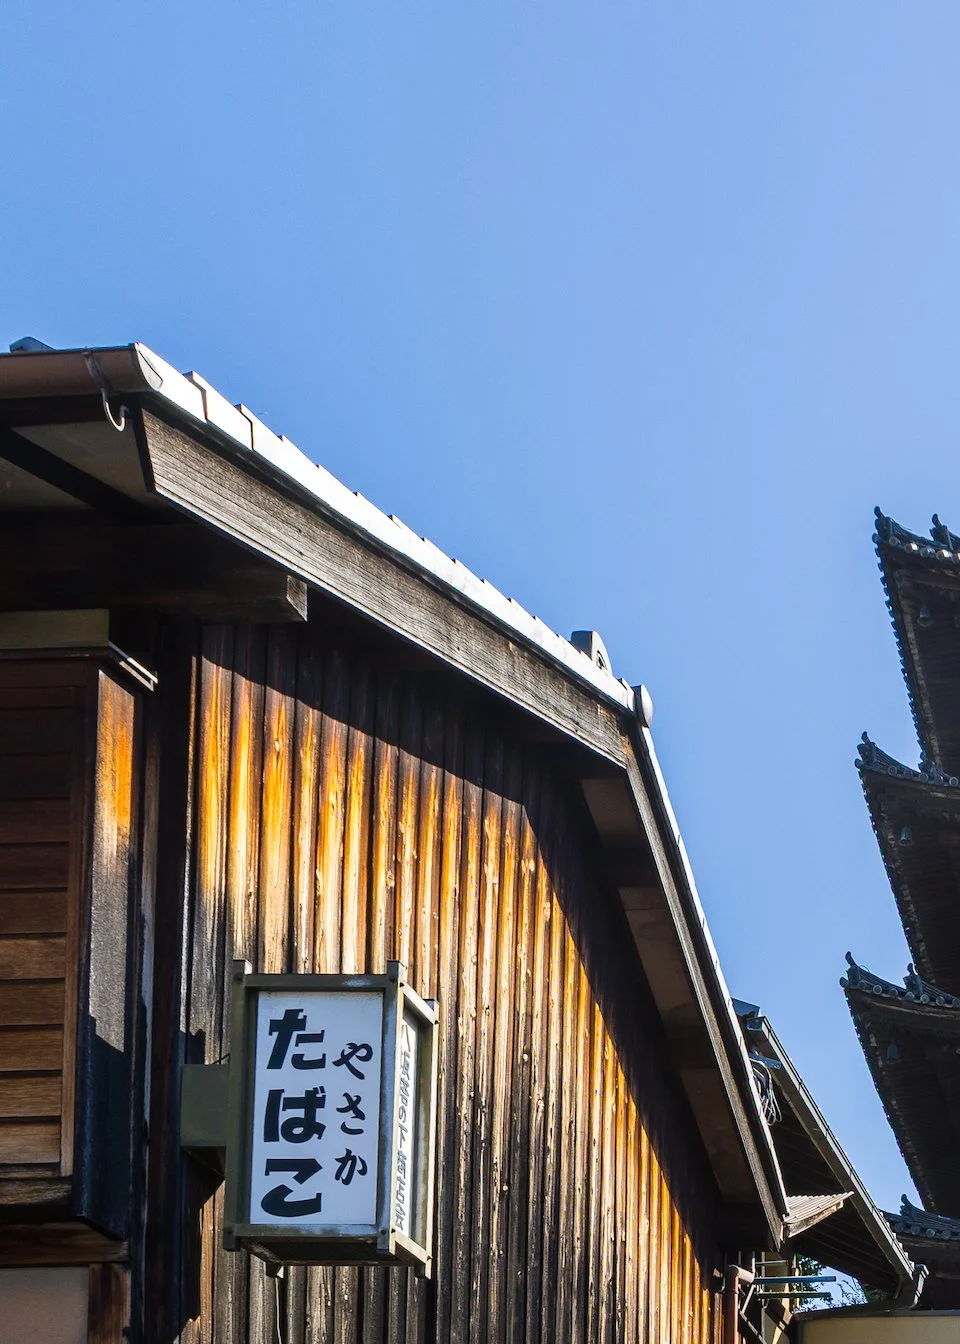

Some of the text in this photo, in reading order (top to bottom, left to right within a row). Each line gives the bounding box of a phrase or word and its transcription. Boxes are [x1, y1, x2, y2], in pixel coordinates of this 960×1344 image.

[261, 1009, 326, 1217] たばこ
[332, 1043, 373, 1185] やさか
